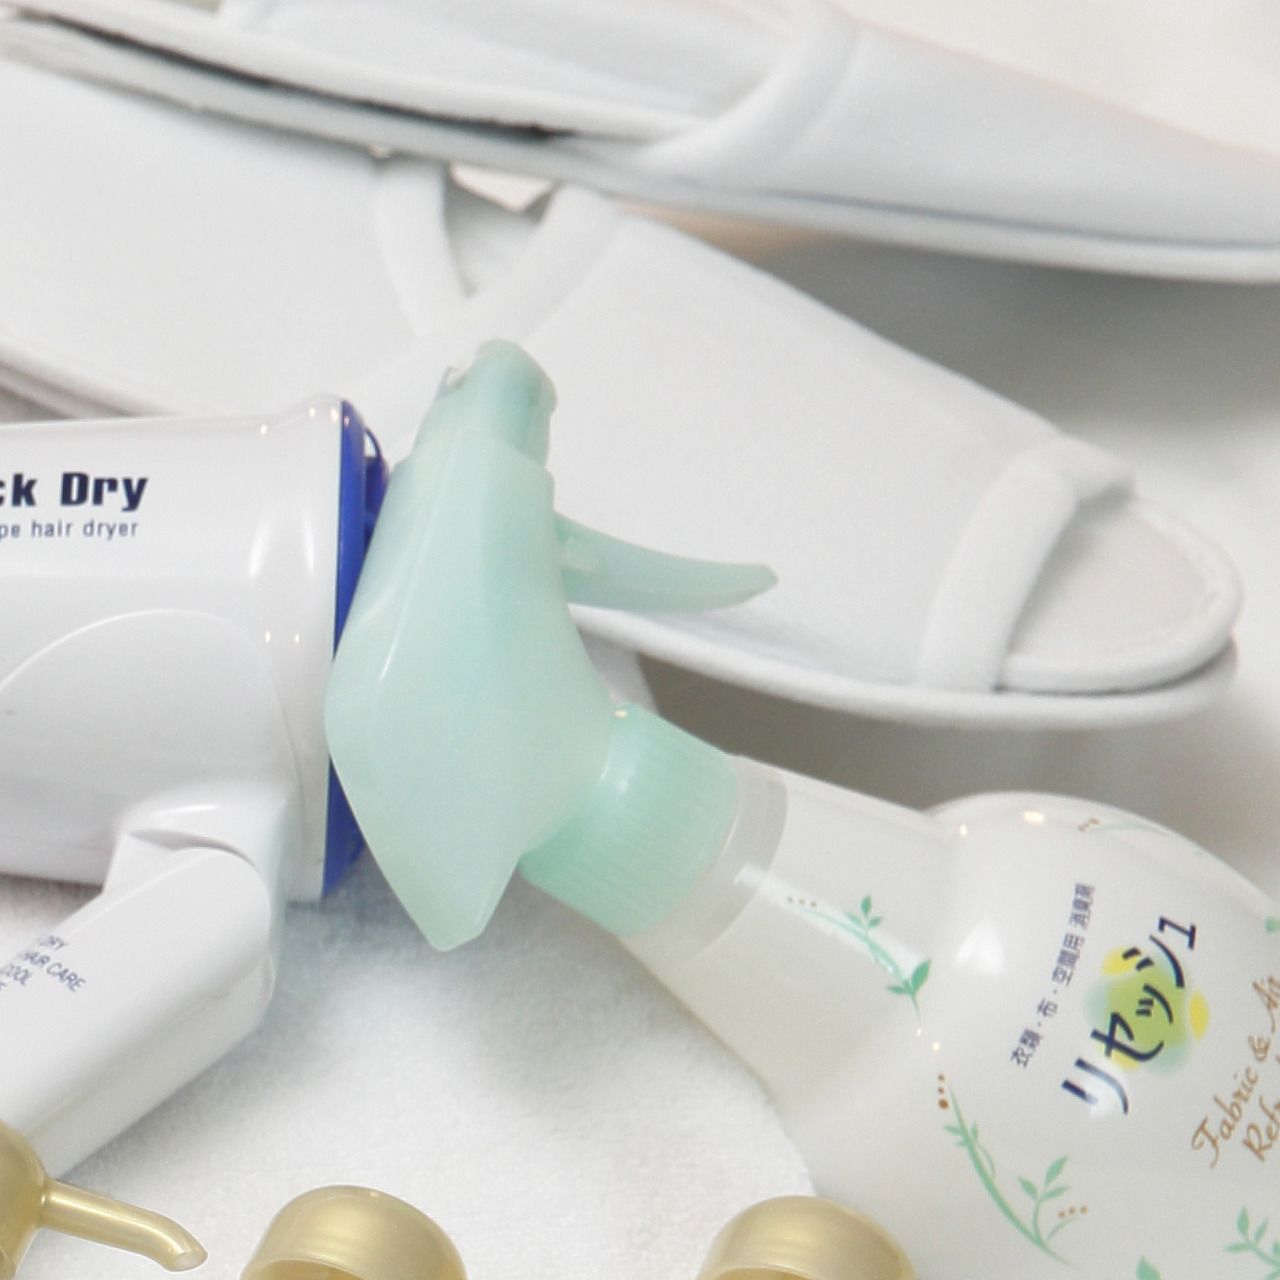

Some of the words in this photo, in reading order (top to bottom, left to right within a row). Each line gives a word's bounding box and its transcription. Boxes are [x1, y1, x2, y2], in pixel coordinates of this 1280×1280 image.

[60, 471, 149, 512] Dry
[30, 519, 74, 539] hair
[82, 518, 140, 541] dryer
[46, 961, 87, 993] CARE
[1061, 915, 1197, 1116] リセッシュ
[1191, 1066, 1259, 1169] Fabric
